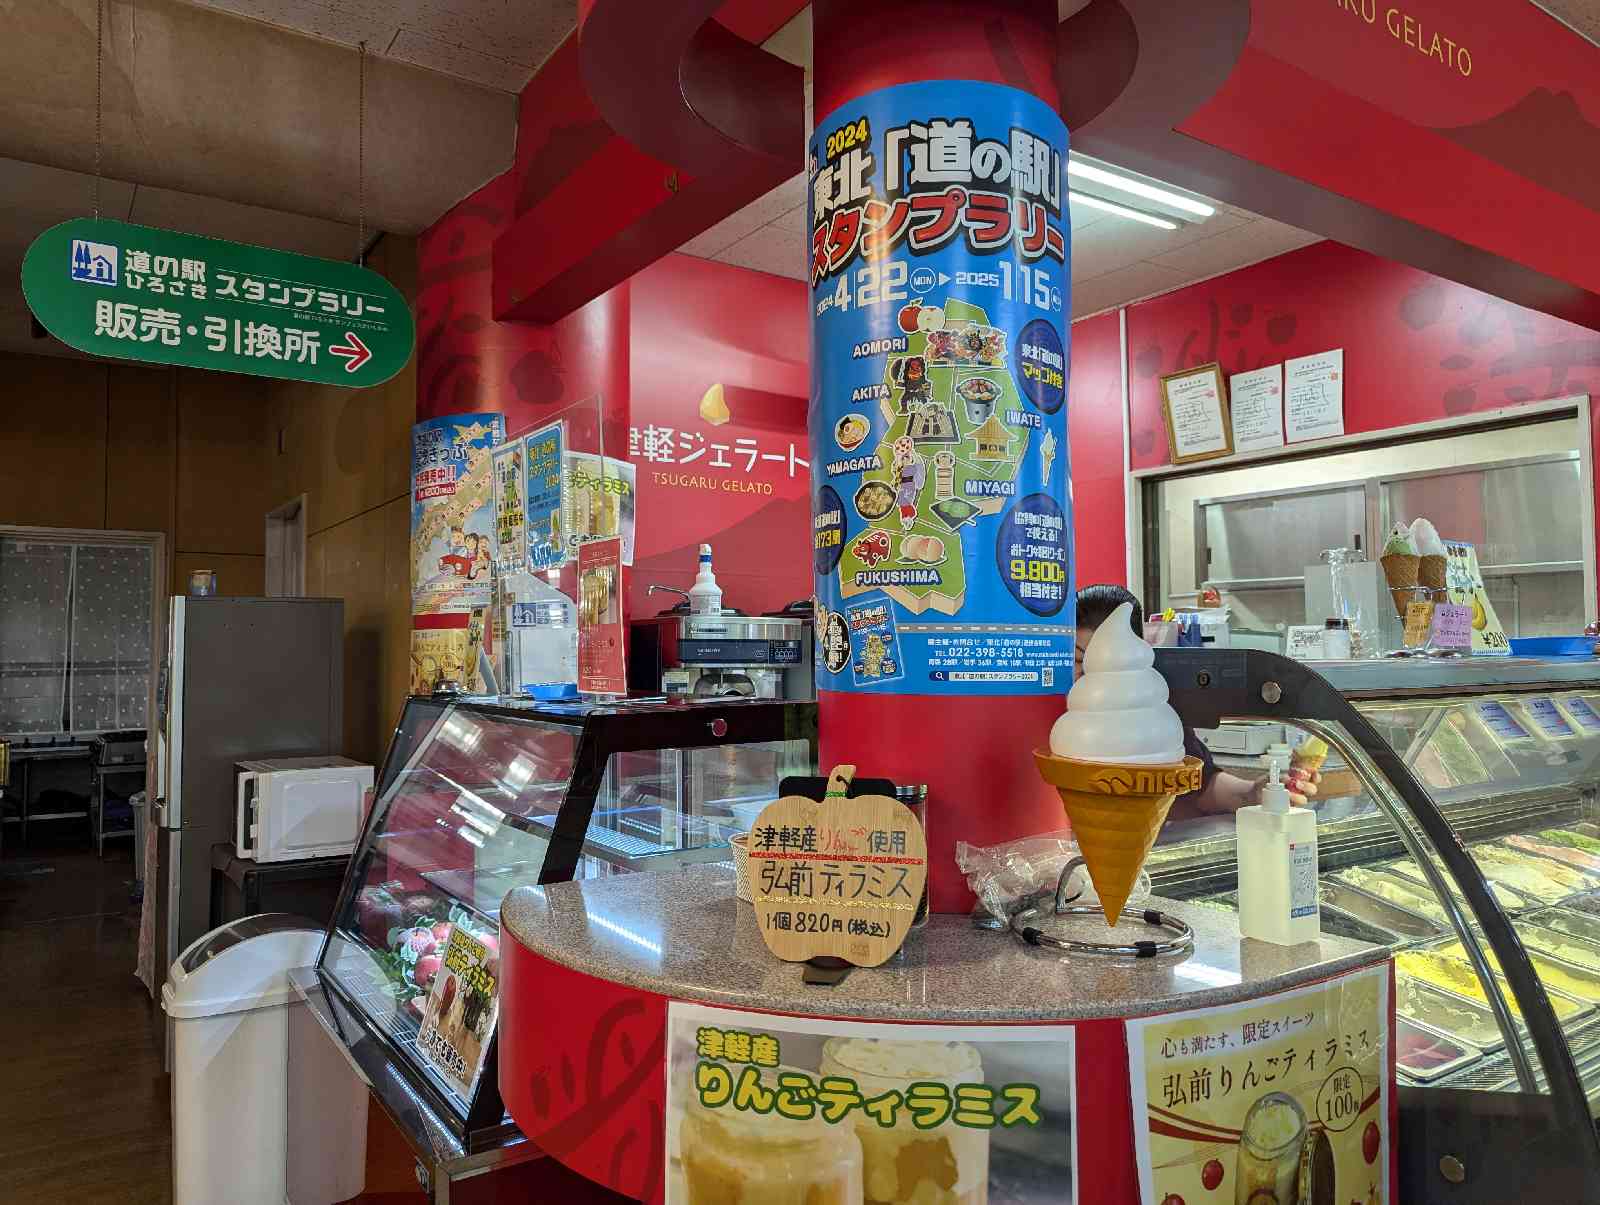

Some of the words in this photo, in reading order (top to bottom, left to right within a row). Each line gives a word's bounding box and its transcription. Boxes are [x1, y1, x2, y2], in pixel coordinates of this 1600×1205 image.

[1386, 8, 1472, 77] GELATO
[826, 118, 869, 157] 2024
[811, 187, 1065, 287] スタンプラリー
[124, 248, 206, 282] 道の駅
[955, 271, 999, 287] 2025
[124, 273, 207, 300] ひろさき
[214, 273, 386, 316] スタンプラリー
[94, 298, 322, 366] 販売・引換所
[852, 337, 907, 358] AOMORI
[851, 382, 891, 402] AKITA
[1006, 410, 1042, 428] IWATE
[826, 455, 881, 475] YAMAGATA
[652, 471, 717, 490] TSUGARU
[721, 479, 773, 496] GELATO
[965, 479, 1015, 496] MIYAGI
[855, 569, 941, 586] FUKUSHIMA
[948, 647, 1024, 658] 022-398-5518
[754, 824, 907, 855] 津軽産りんご使用
[760, 861, 913, 899] 弘前ティラミス
[766, 910, 892, 939] 1個820円(税込)
[697, 1028, 780, 1067] 津軽産
[1161, 1011, 1316, 1059] 心も満たす、限定スイーツ
[1162, 1029, 1370, 1109] 弘前りんごティラミス
[1333, 1073, 1352, 1090] 限定
[695, 1064, 1043, 1130] りんごティラミス
